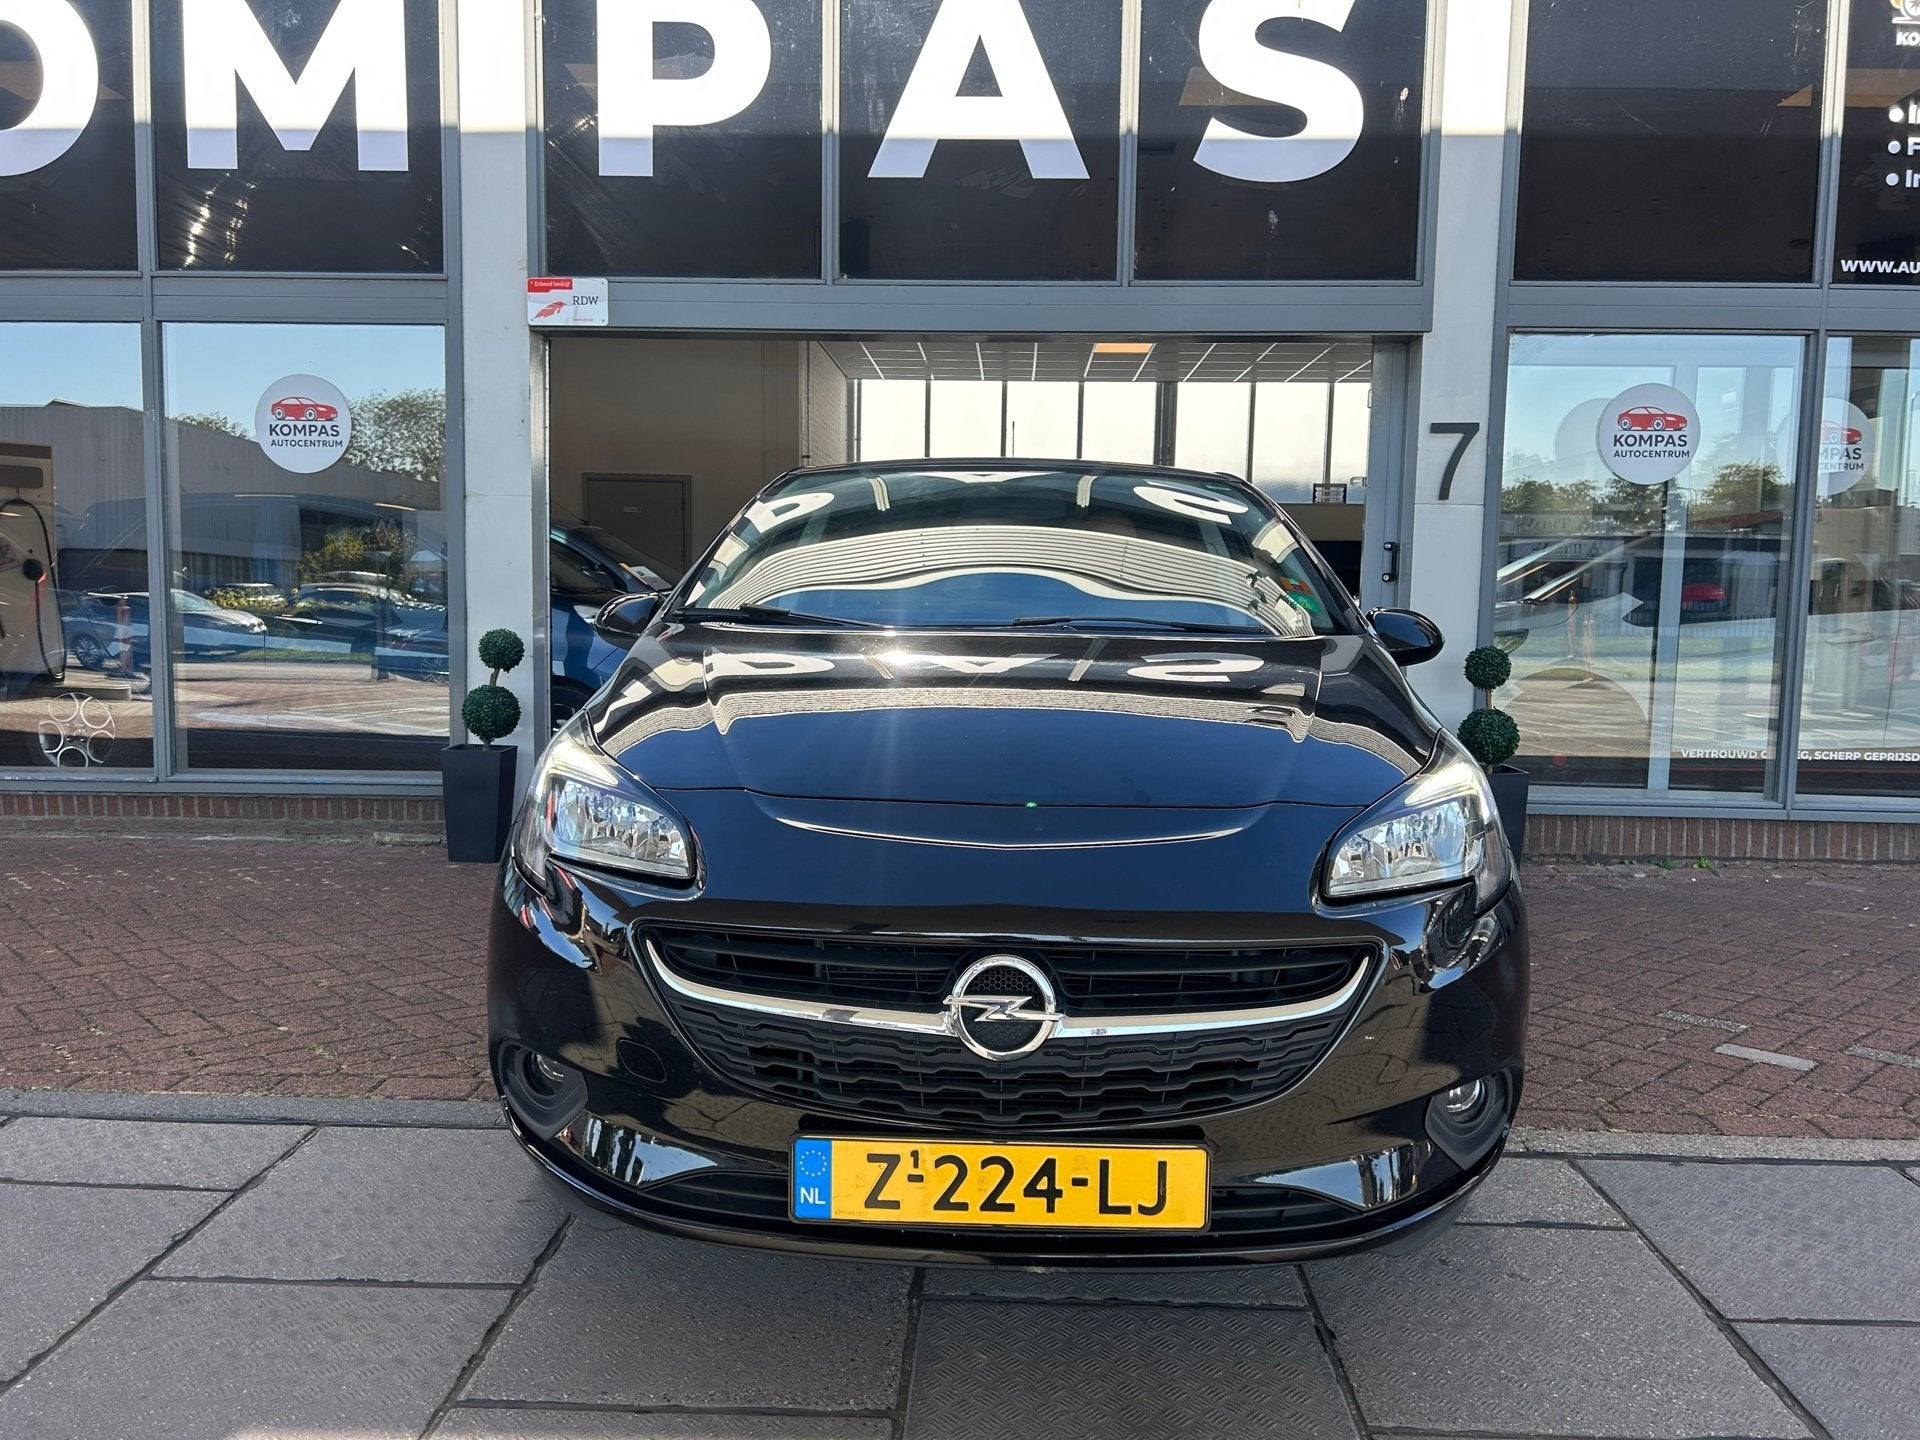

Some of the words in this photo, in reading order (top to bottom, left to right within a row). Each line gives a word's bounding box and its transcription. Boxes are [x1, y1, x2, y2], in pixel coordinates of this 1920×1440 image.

[572, 295, 599, 306] RDW
[269, 423, 340, 437] KOMPAS
[271, 439, 343, 448] AUTOCENTRUM
[1613, 434, 1688, 447] KOMPAS
[1613, 450, 1690, 458] AUTOCENTRUM
[1430, 422, 1480, 500] 7
[1681, 749, 1757, 759] VERTROUWD
[1814, 751, 1861, 761] SCHERP
[1864, 752, 1920, 762] GEPRIJSD
[800, 1187, 826, 1205] NL
